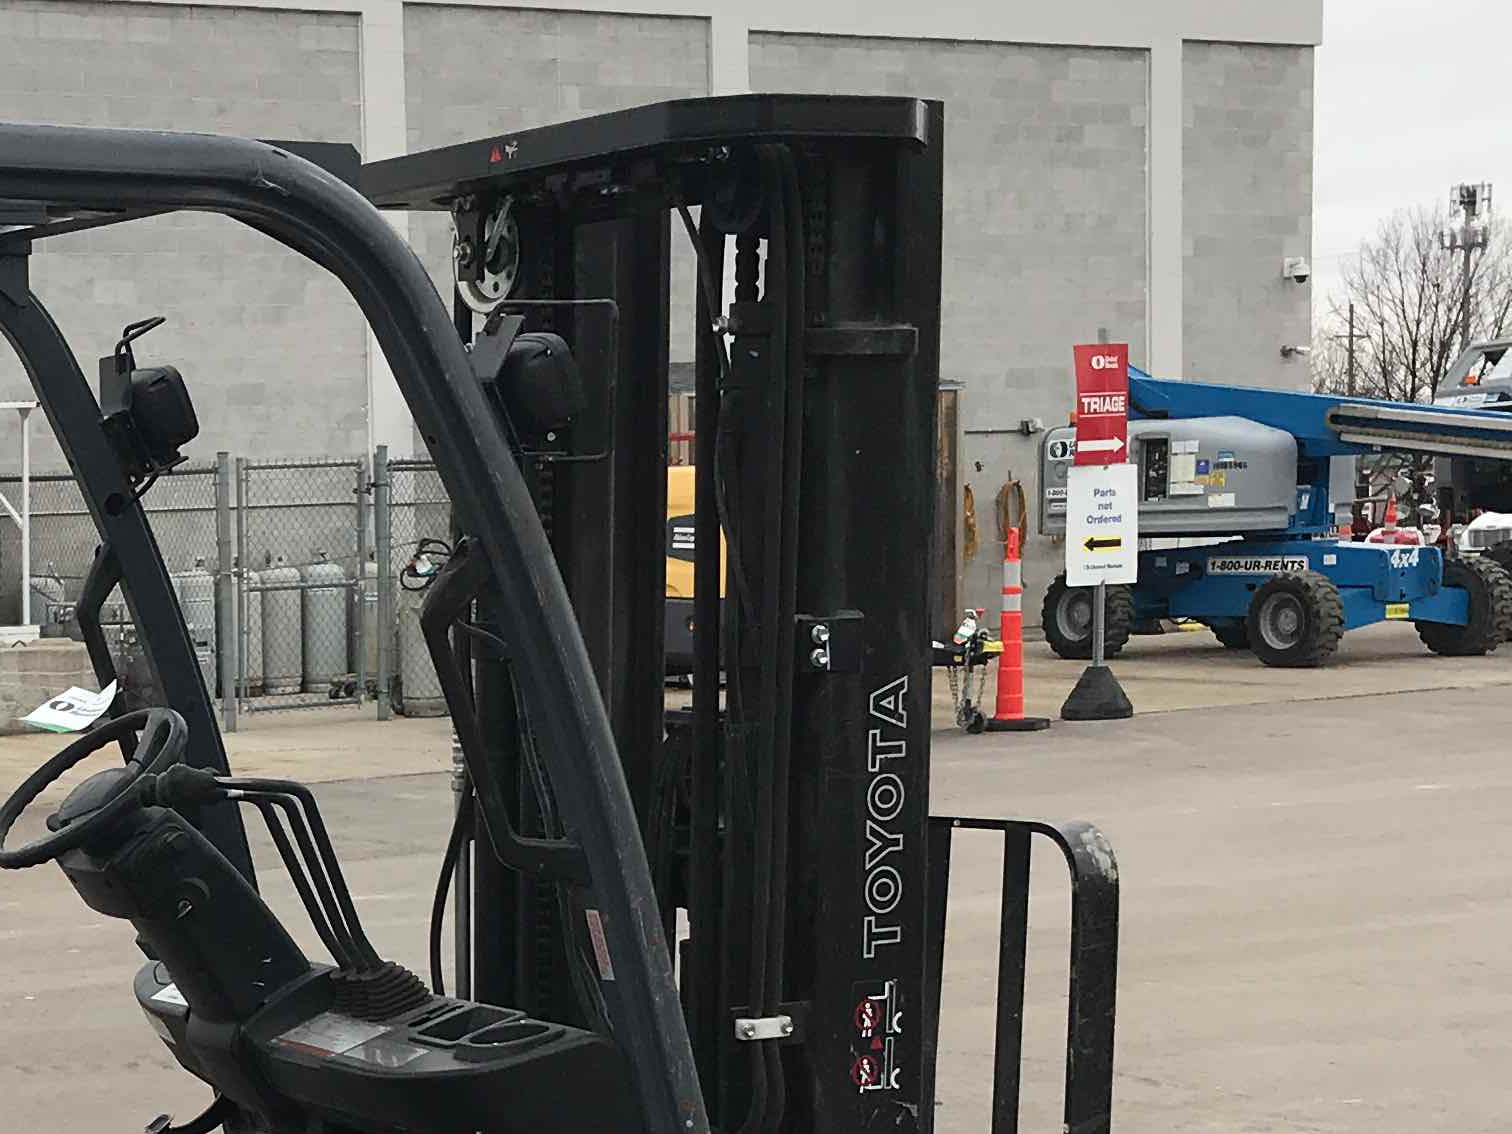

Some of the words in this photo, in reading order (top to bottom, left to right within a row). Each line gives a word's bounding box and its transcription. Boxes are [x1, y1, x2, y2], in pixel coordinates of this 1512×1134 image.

[1081, 396, 1126, 414] TRIAGE
[1093, 488, 1116, 497] Parts
[1086, 514, 1122, 524] Ordered
[1210, 560, 1305, 571] 1-800-UR-RENTS
[1390, 551, 1419, 568] 4x4
[863, 675, 908, 959] TOYOTA
